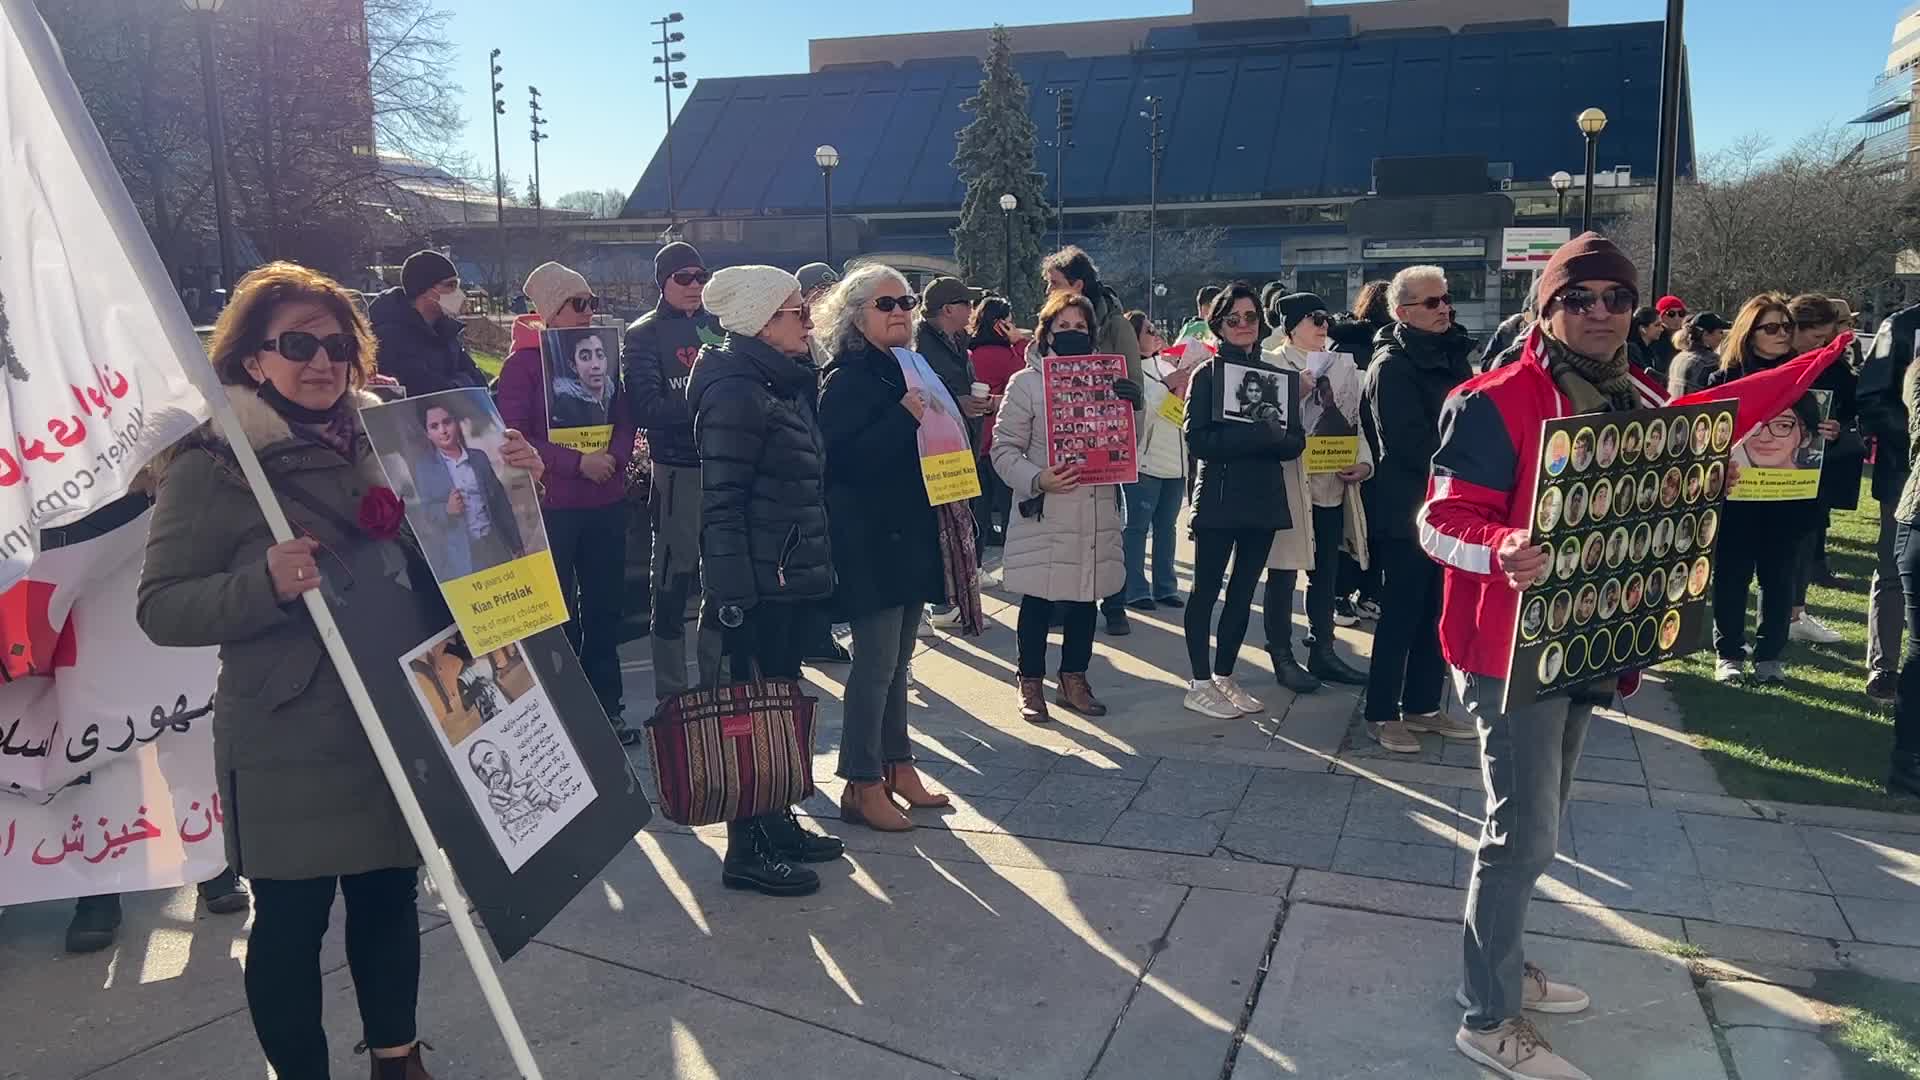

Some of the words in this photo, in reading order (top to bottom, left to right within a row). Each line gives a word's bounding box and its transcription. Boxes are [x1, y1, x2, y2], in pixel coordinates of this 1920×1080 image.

[472, 581, 483, 592] 10
[503, 570, 515, 582] old
[472, 600, 493, 615] Kian
[493, 585, 533, 607] Pirfalak
[517, 600, 550, 619] children
[31, 806, 161, 865] خیزش
